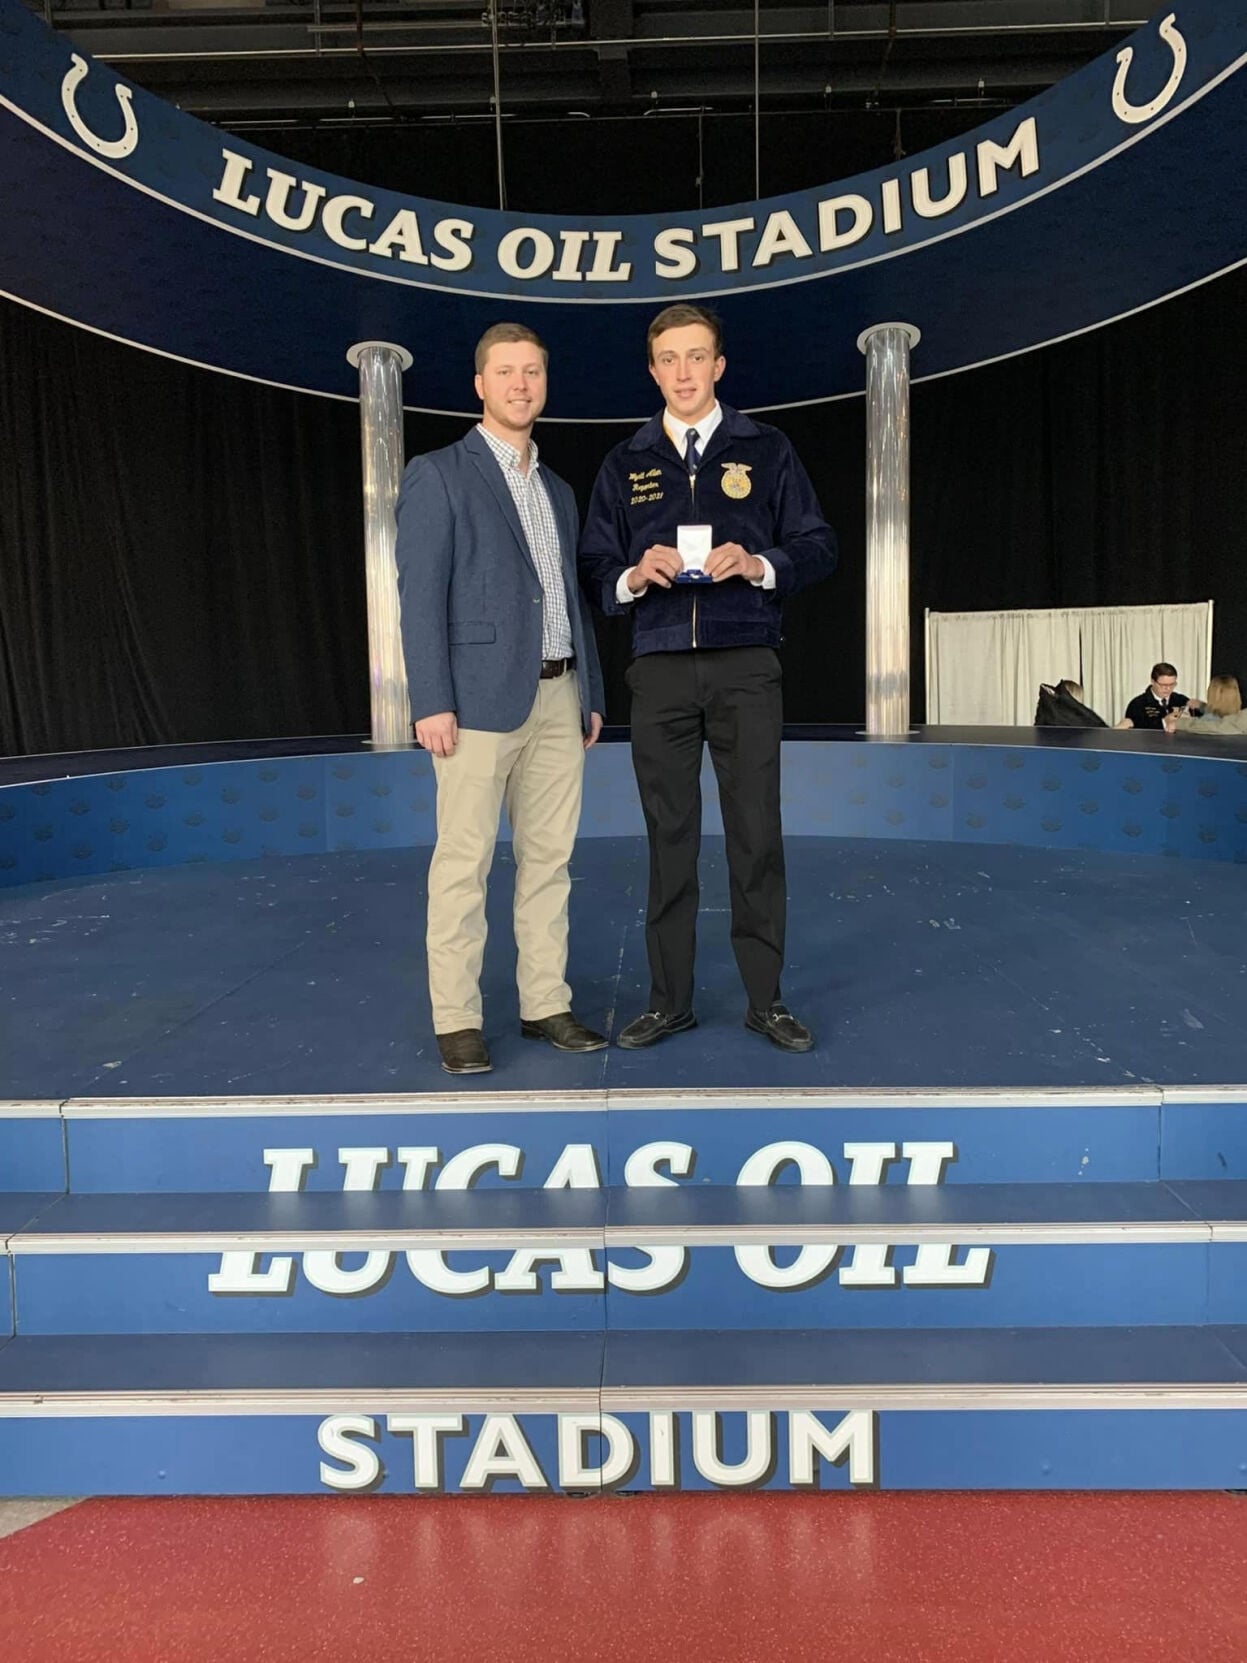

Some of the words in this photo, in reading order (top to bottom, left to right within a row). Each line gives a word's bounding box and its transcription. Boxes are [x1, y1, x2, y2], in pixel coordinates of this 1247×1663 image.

[213, 149, 475, 271] LUCAS
[498, 228, 632, 282] OIL
[654, 117, 1040, 279] STADIUM
[317, 1411, 876, 1490] STADIUM
